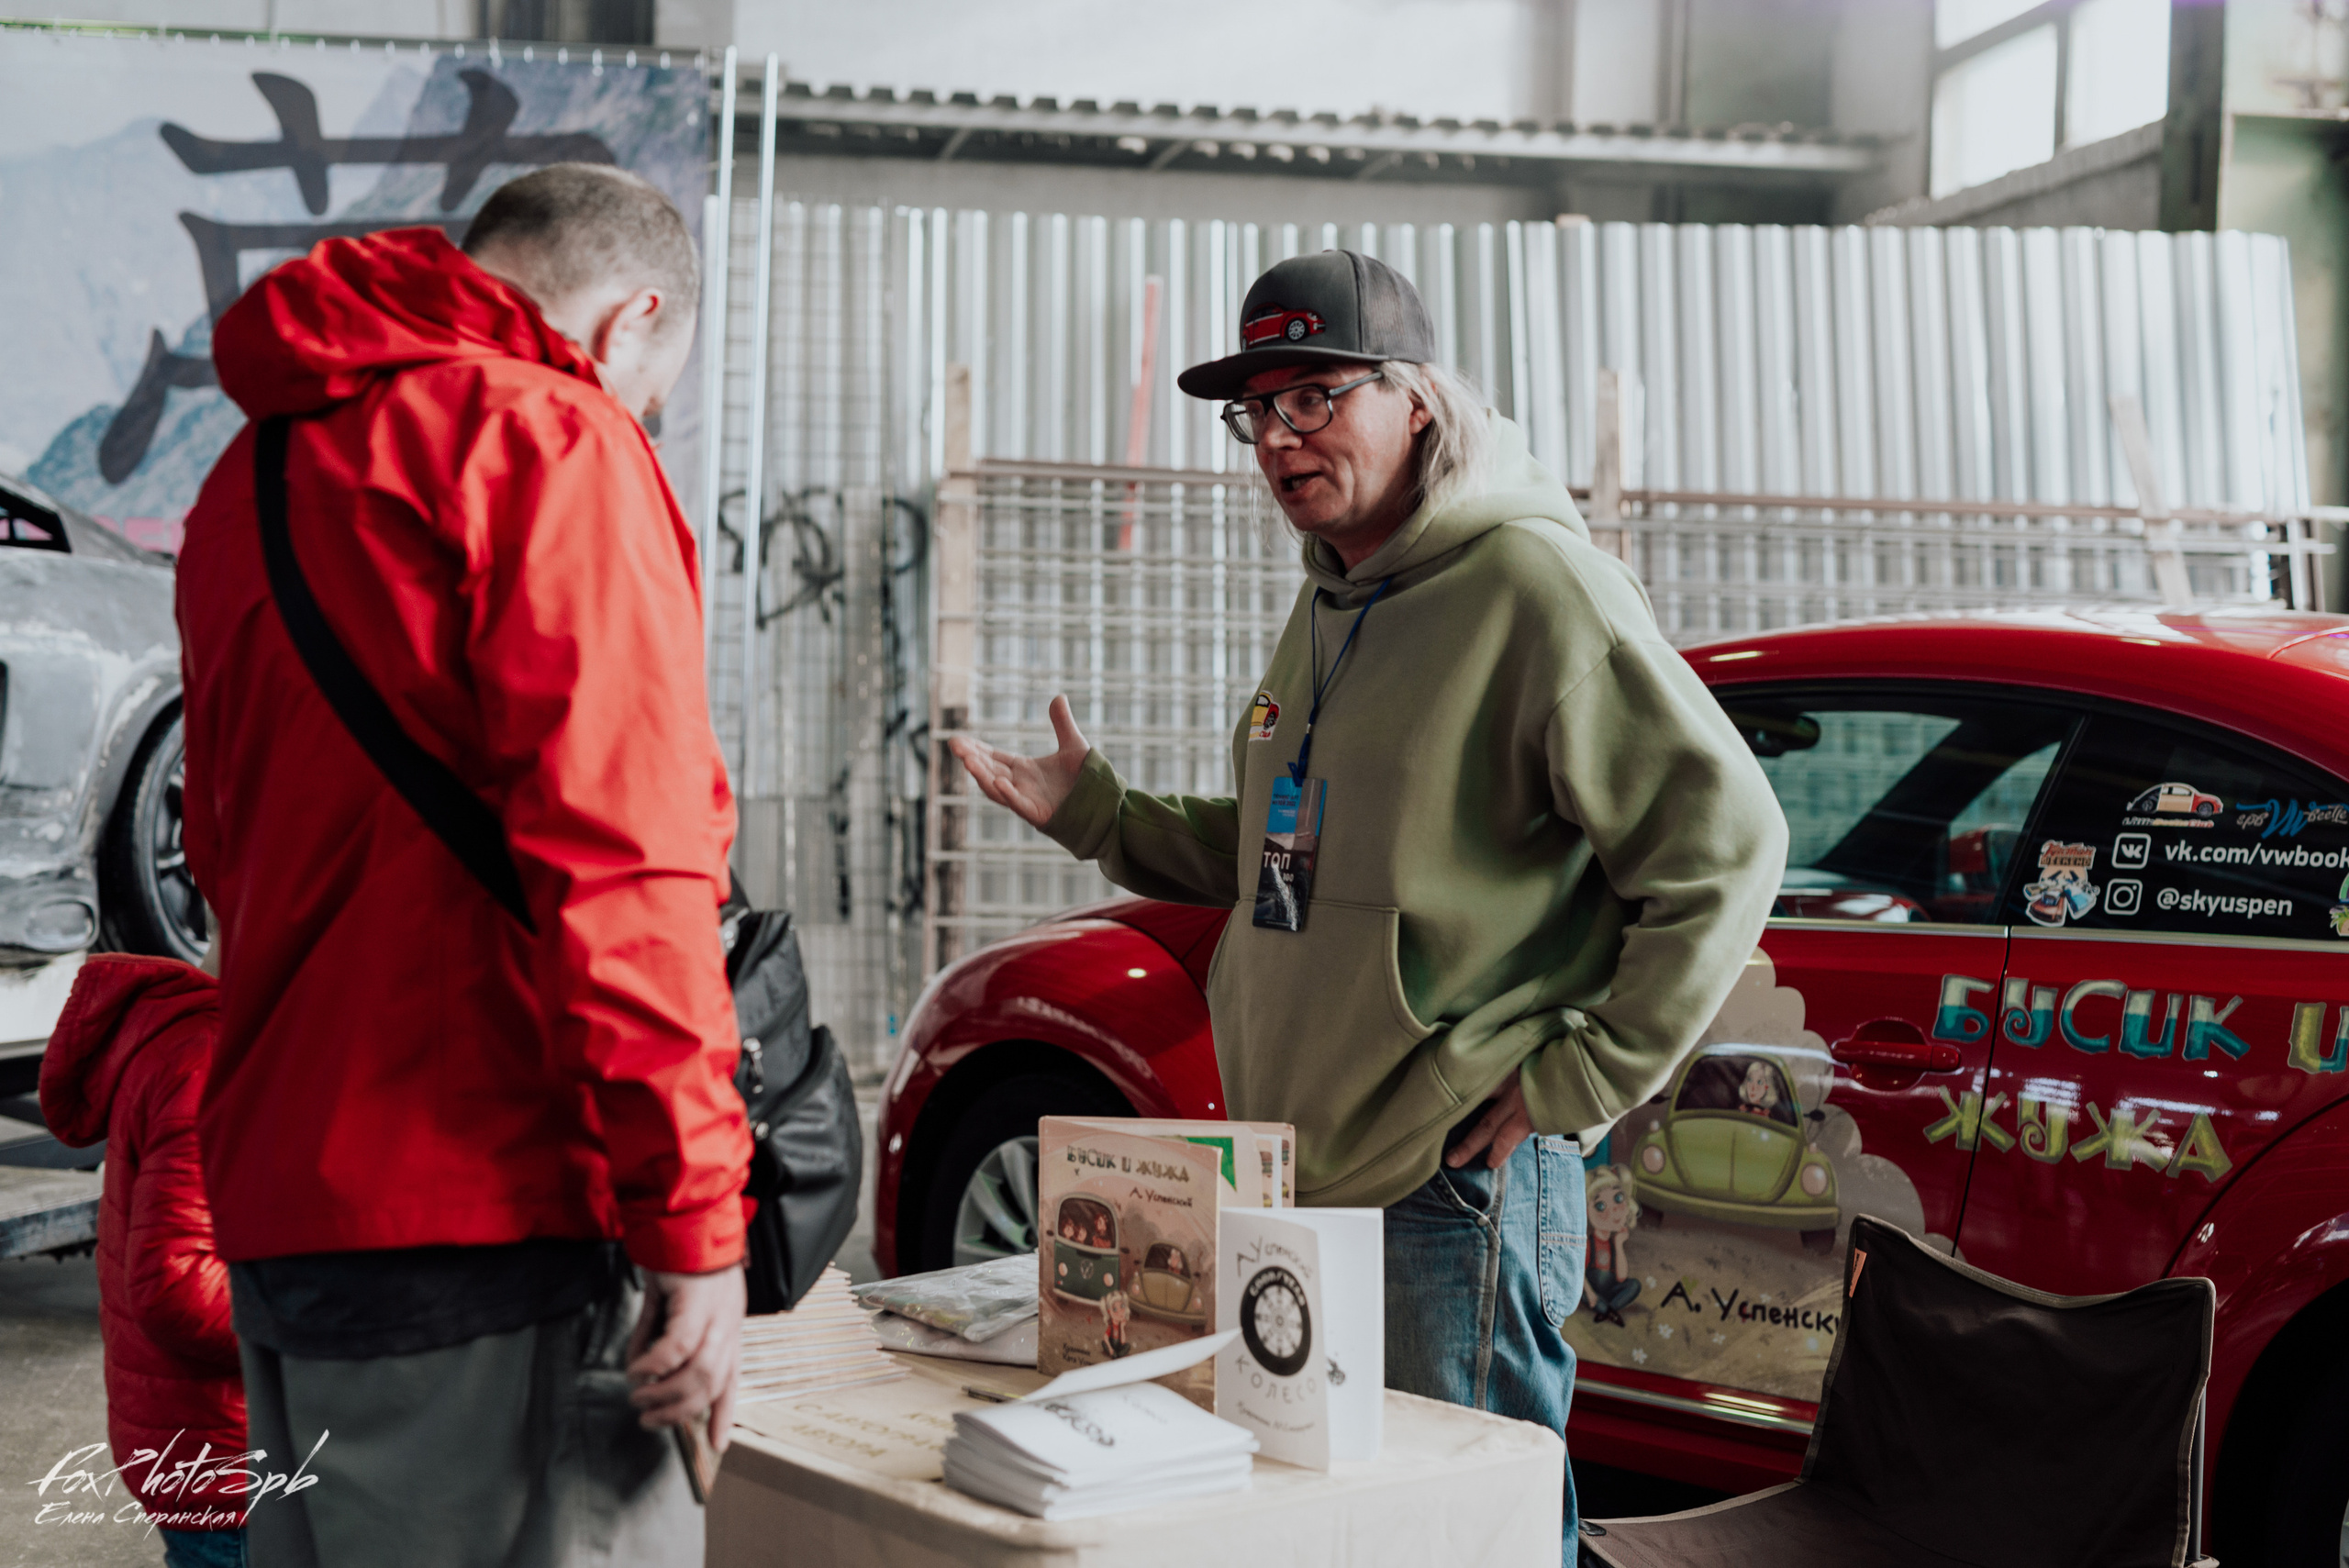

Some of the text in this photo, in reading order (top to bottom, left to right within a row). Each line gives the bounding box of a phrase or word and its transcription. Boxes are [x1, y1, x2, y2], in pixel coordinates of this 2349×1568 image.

[1264, 851, 1291, 870] ТОП
[2156, 887, 2293, 919] @skyuspen
[1923, 1084, 2233, 1184] ЖУЖА
[1660, 1281, 1702, 1314] А.
[1235, 1354, 1317, 1405] КОЛЕСО
